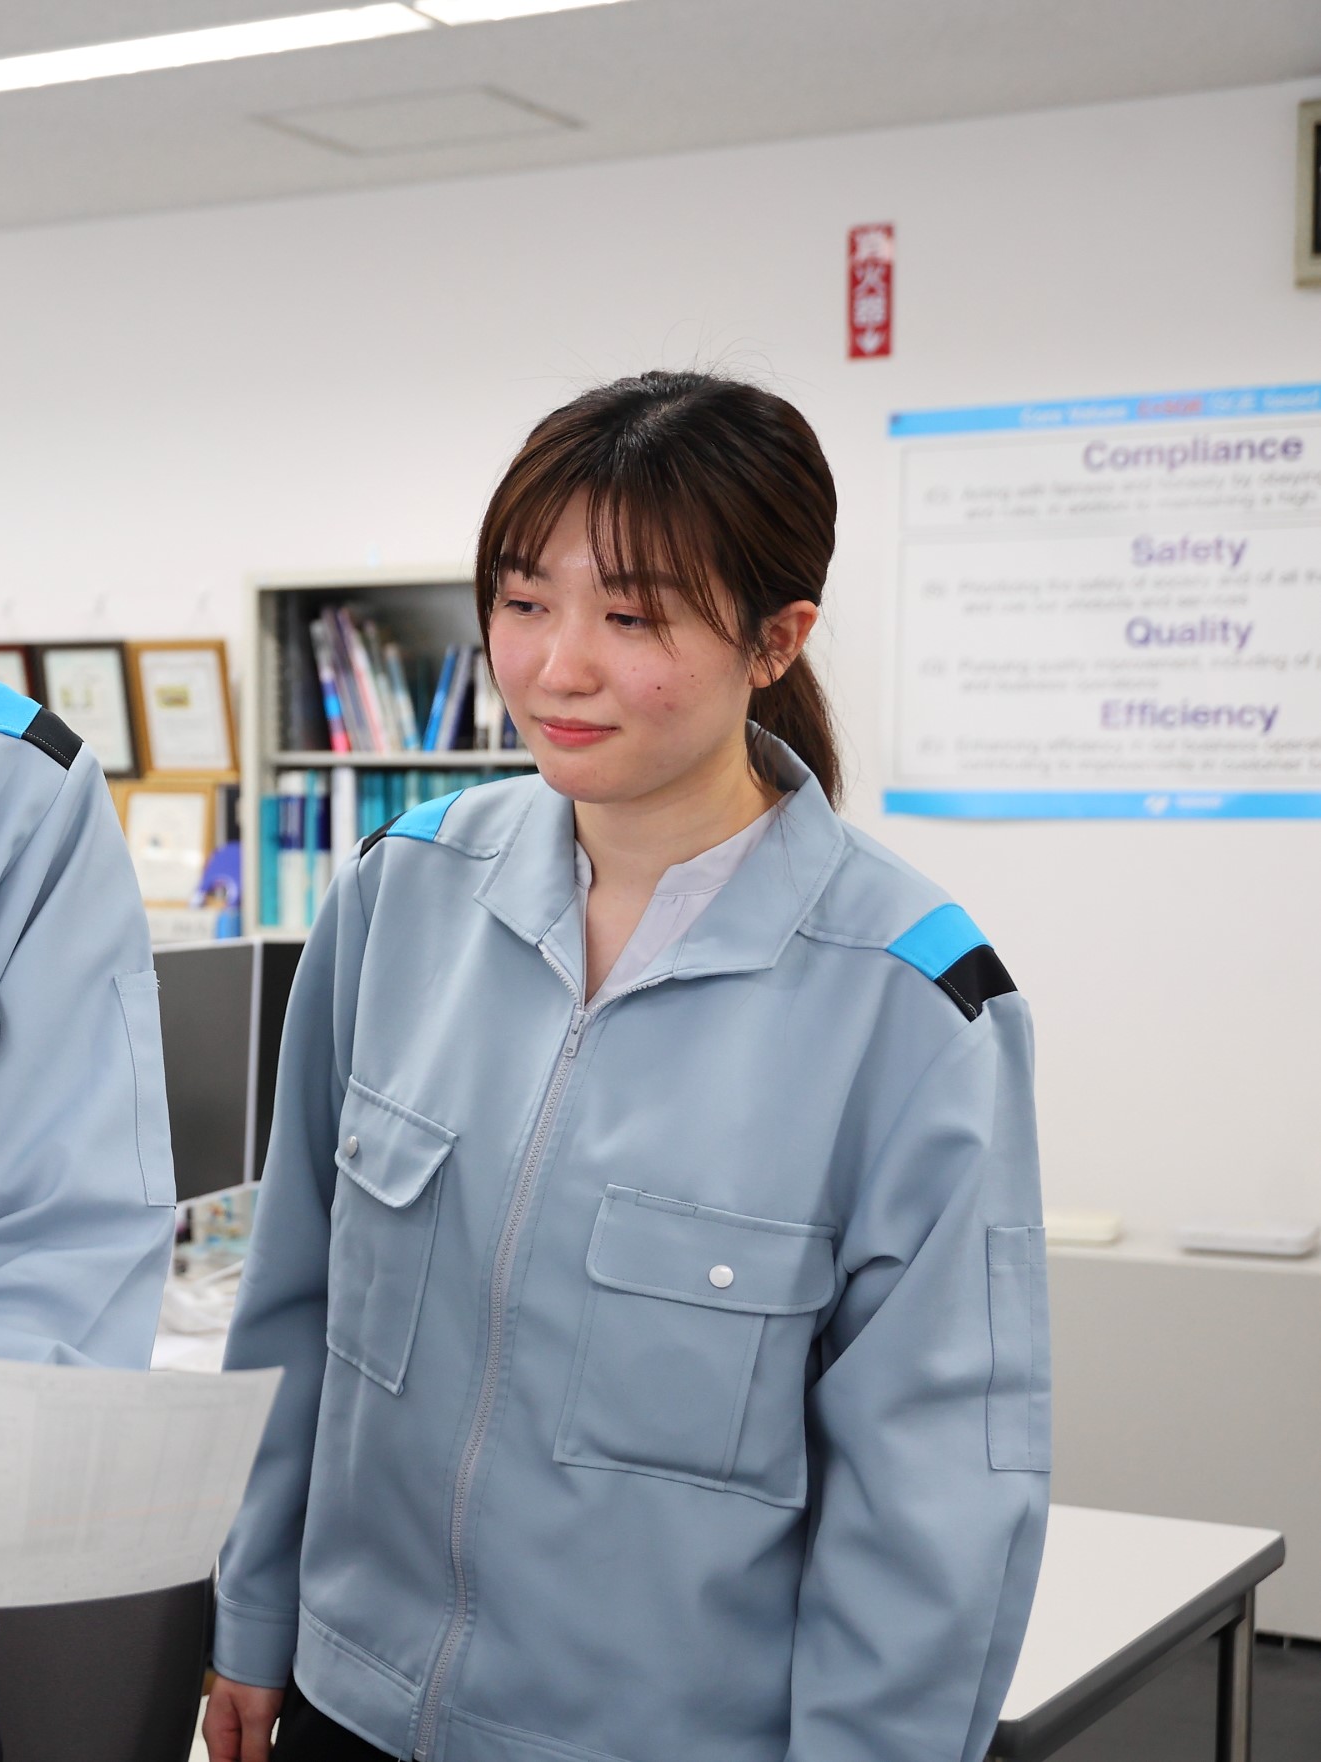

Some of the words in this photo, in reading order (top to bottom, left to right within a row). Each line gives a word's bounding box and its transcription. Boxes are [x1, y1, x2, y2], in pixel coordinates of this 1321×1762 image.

[1083, 434, 1304, 473] Compliance
[1132, 536, 1248, 569] Safety
[1124, 616, 1254, 652] Quality
[1100, 699, 1280, 736] Efficiency
